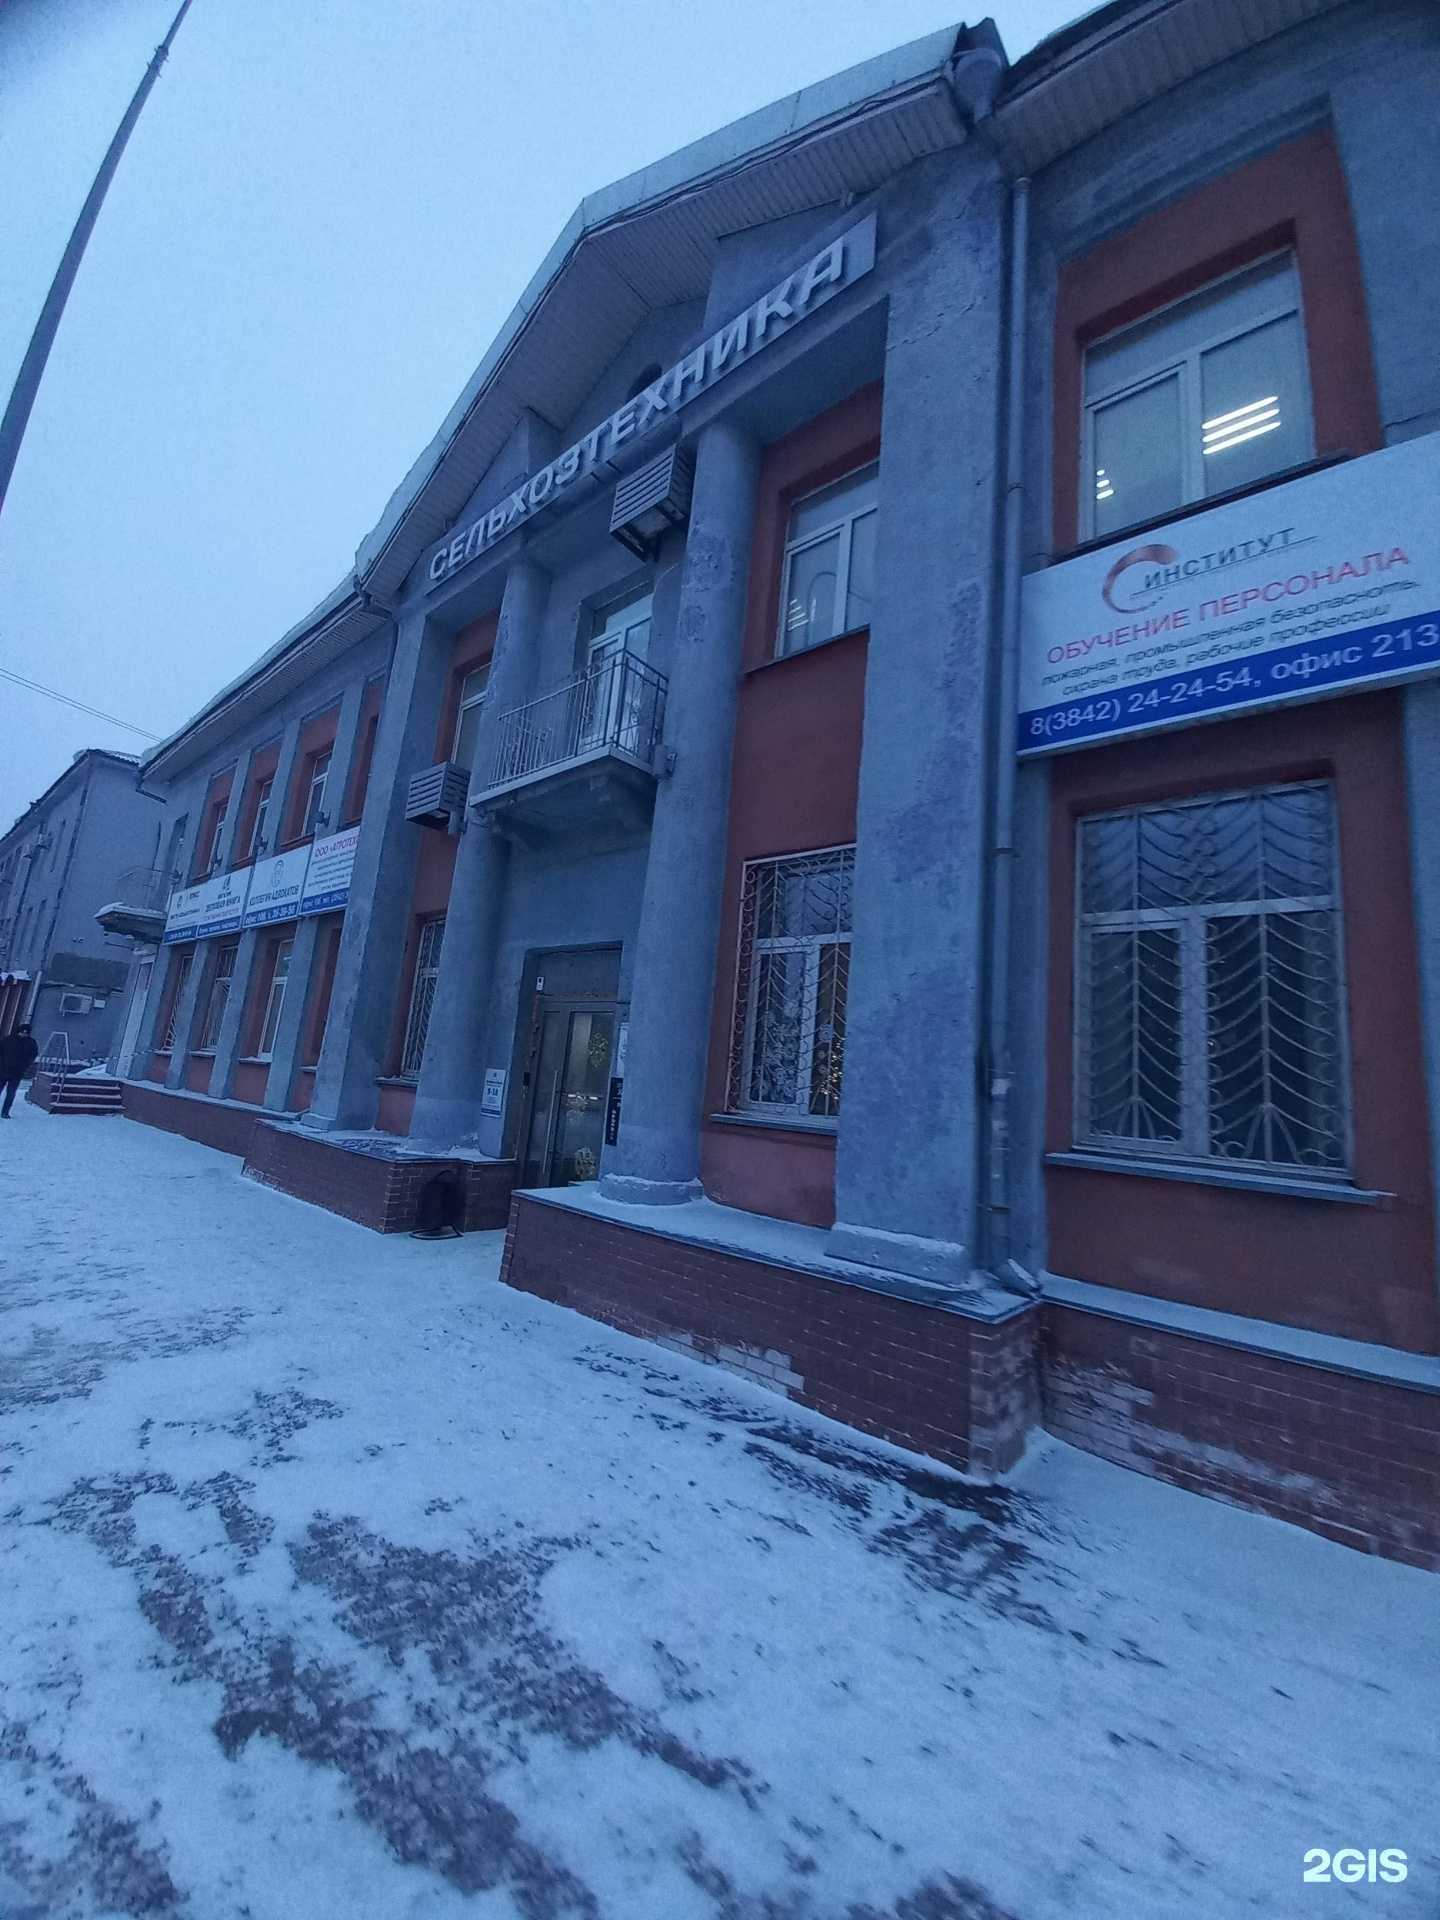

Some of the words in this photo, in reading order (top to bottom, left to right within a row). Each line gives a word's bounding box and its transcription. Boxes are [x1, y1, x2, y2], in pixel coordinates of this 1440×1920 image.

[429, 235, 845, 581] СЕЛЬХОЗТЕХНИКА
[1046, 608, 1191, 664] ОБУЧЕНИЕ
[1199, 547, 1410, 621] ПЕРСОНАЛА
[1144, 527, 1296, 588] ИНСТИТУТ
[1030, 698, 1122, 736] 8(3842)
[1127, 666, 1263, 713] 24-24-54,
[1270, 645, 1365, 679] офис
[1371, 623, 1440, 658] 213
[1062, 674, 1119, 696] охрана
[1185, 636, 1266, 667] рабочие
[1269, 604, 1392, 645] профессии
[1123, 617, 1267, 664] промышленная
